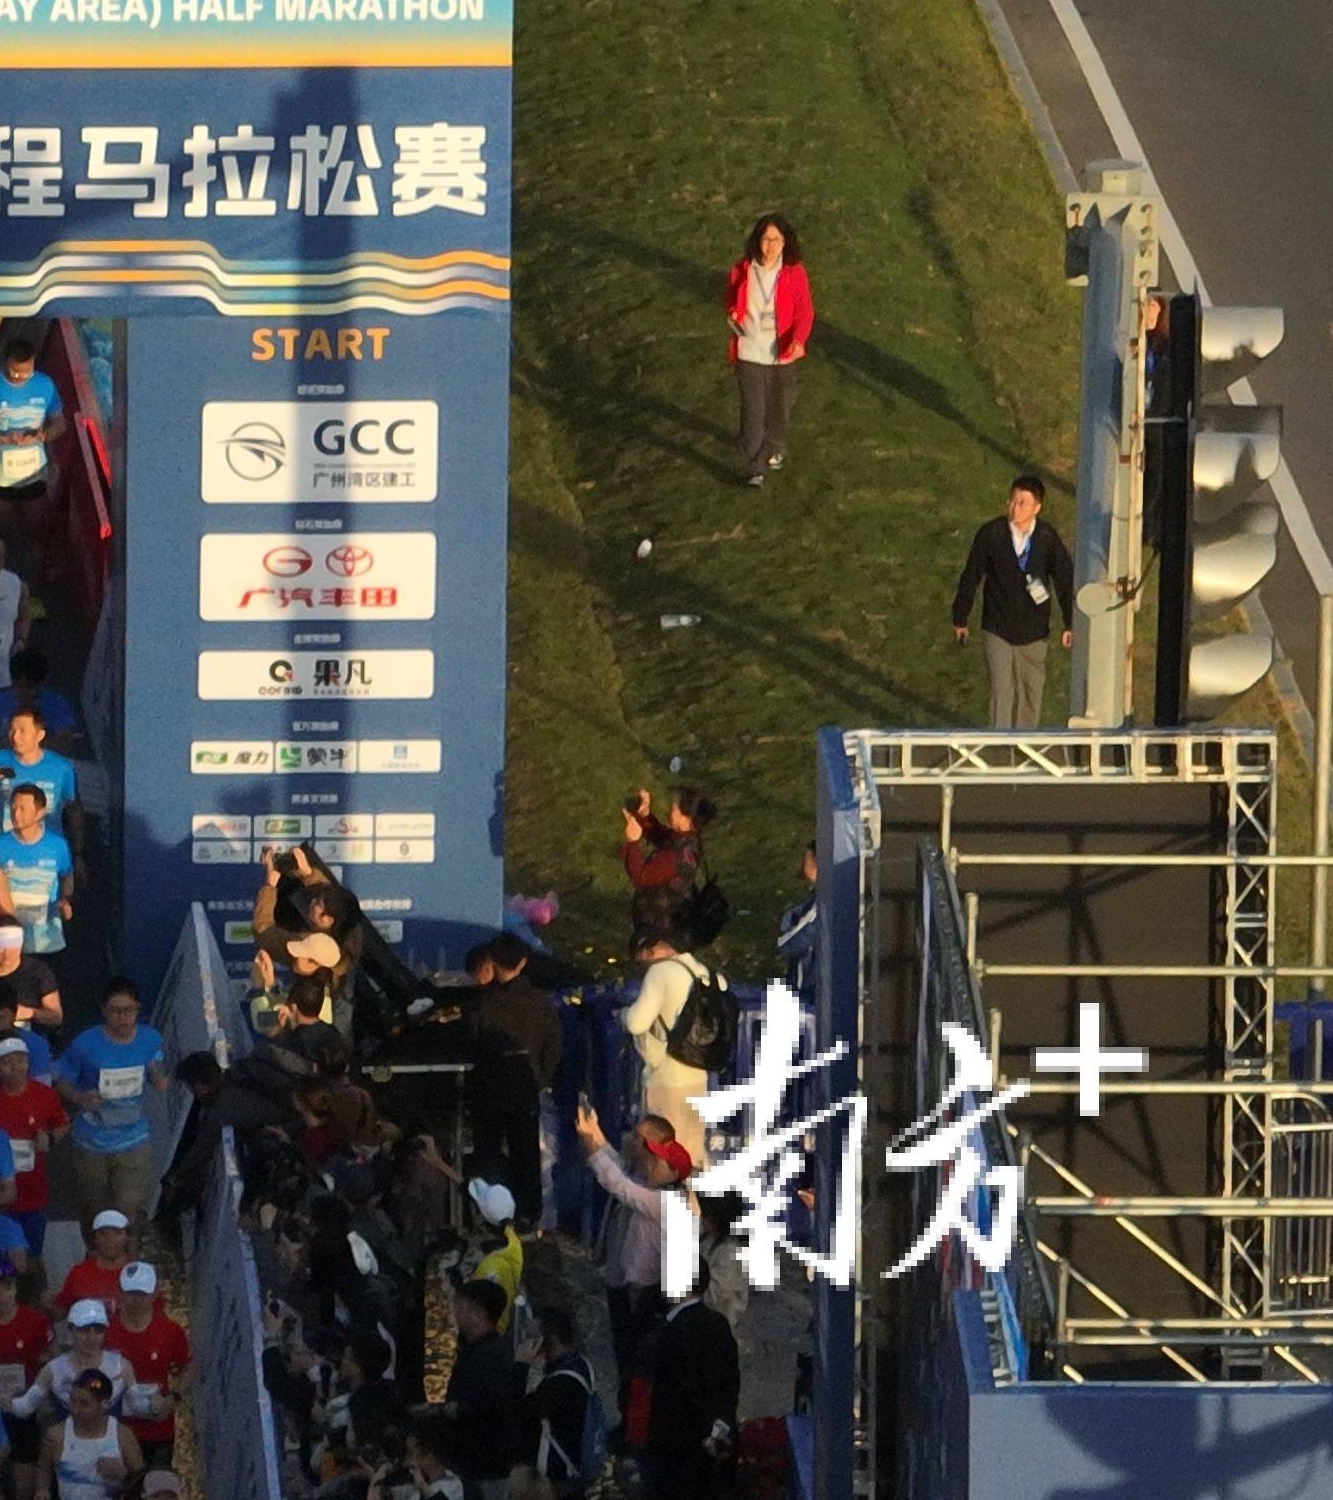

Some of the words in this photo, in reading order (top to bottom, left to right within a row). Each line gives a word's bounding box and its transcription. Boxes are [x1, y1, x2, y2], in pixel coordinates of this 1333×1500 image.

[251, 327, 391, 362] START
[313, 419, 416, 456] GCC
[312, 471, 416, 488] 广州湾区建工
[238, 586, 398, 608] 广汽丰田
